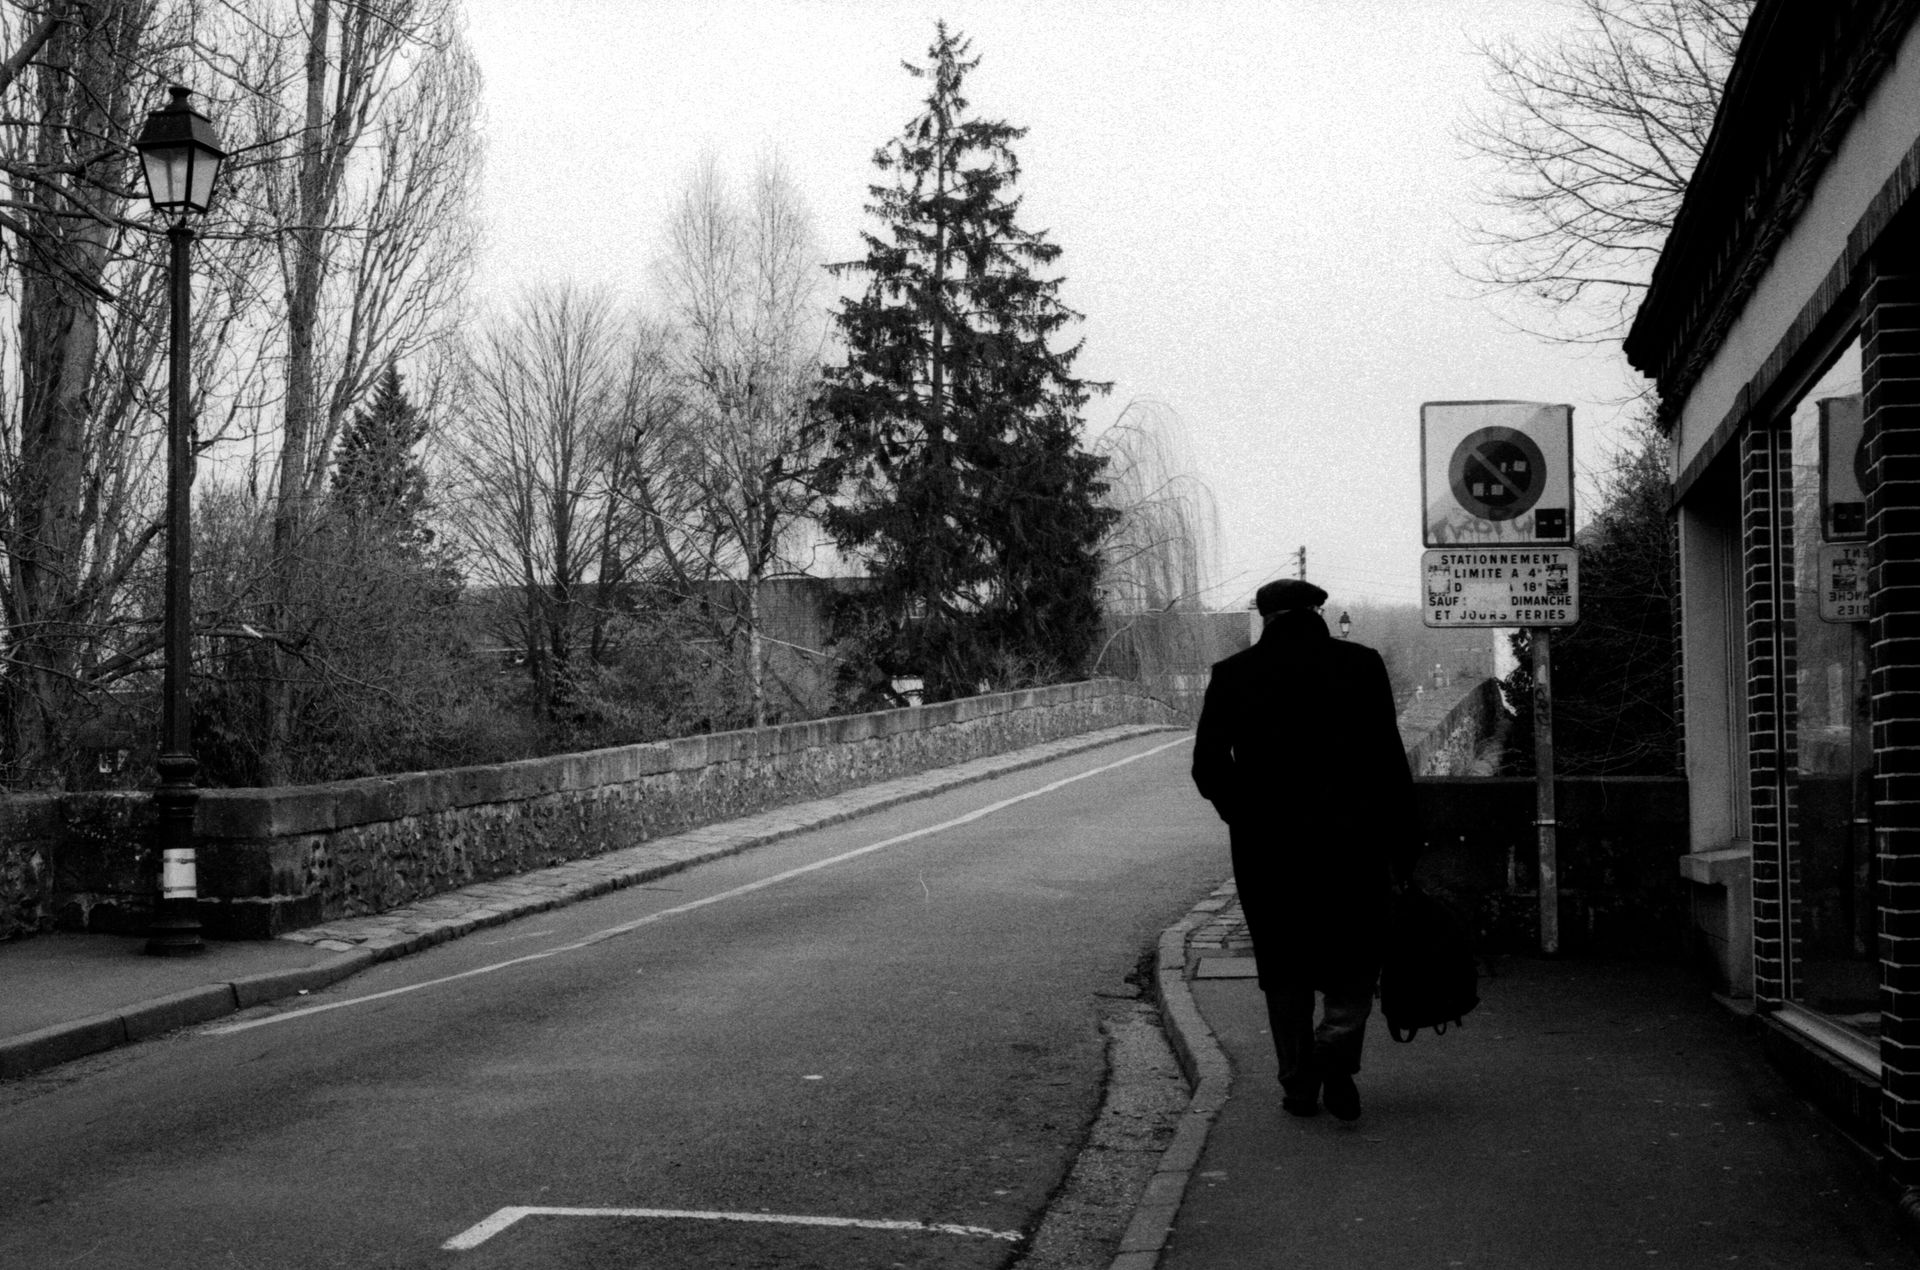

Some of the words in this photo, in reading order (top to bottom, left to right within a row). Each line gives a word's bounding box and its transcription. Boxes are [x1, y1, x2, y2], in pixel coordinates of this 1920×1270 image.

[1441, 554, 1559, 565] STATIONNEMENT
[1454, 568, 1502, 578] LIMITE
[1511, 568, 1519, 578] A
[1511, 596, 1572, 606] DIMANCHE
[1435, 610, 1451, 620] ET
[1516, 609, 1566, 620] FERIES
